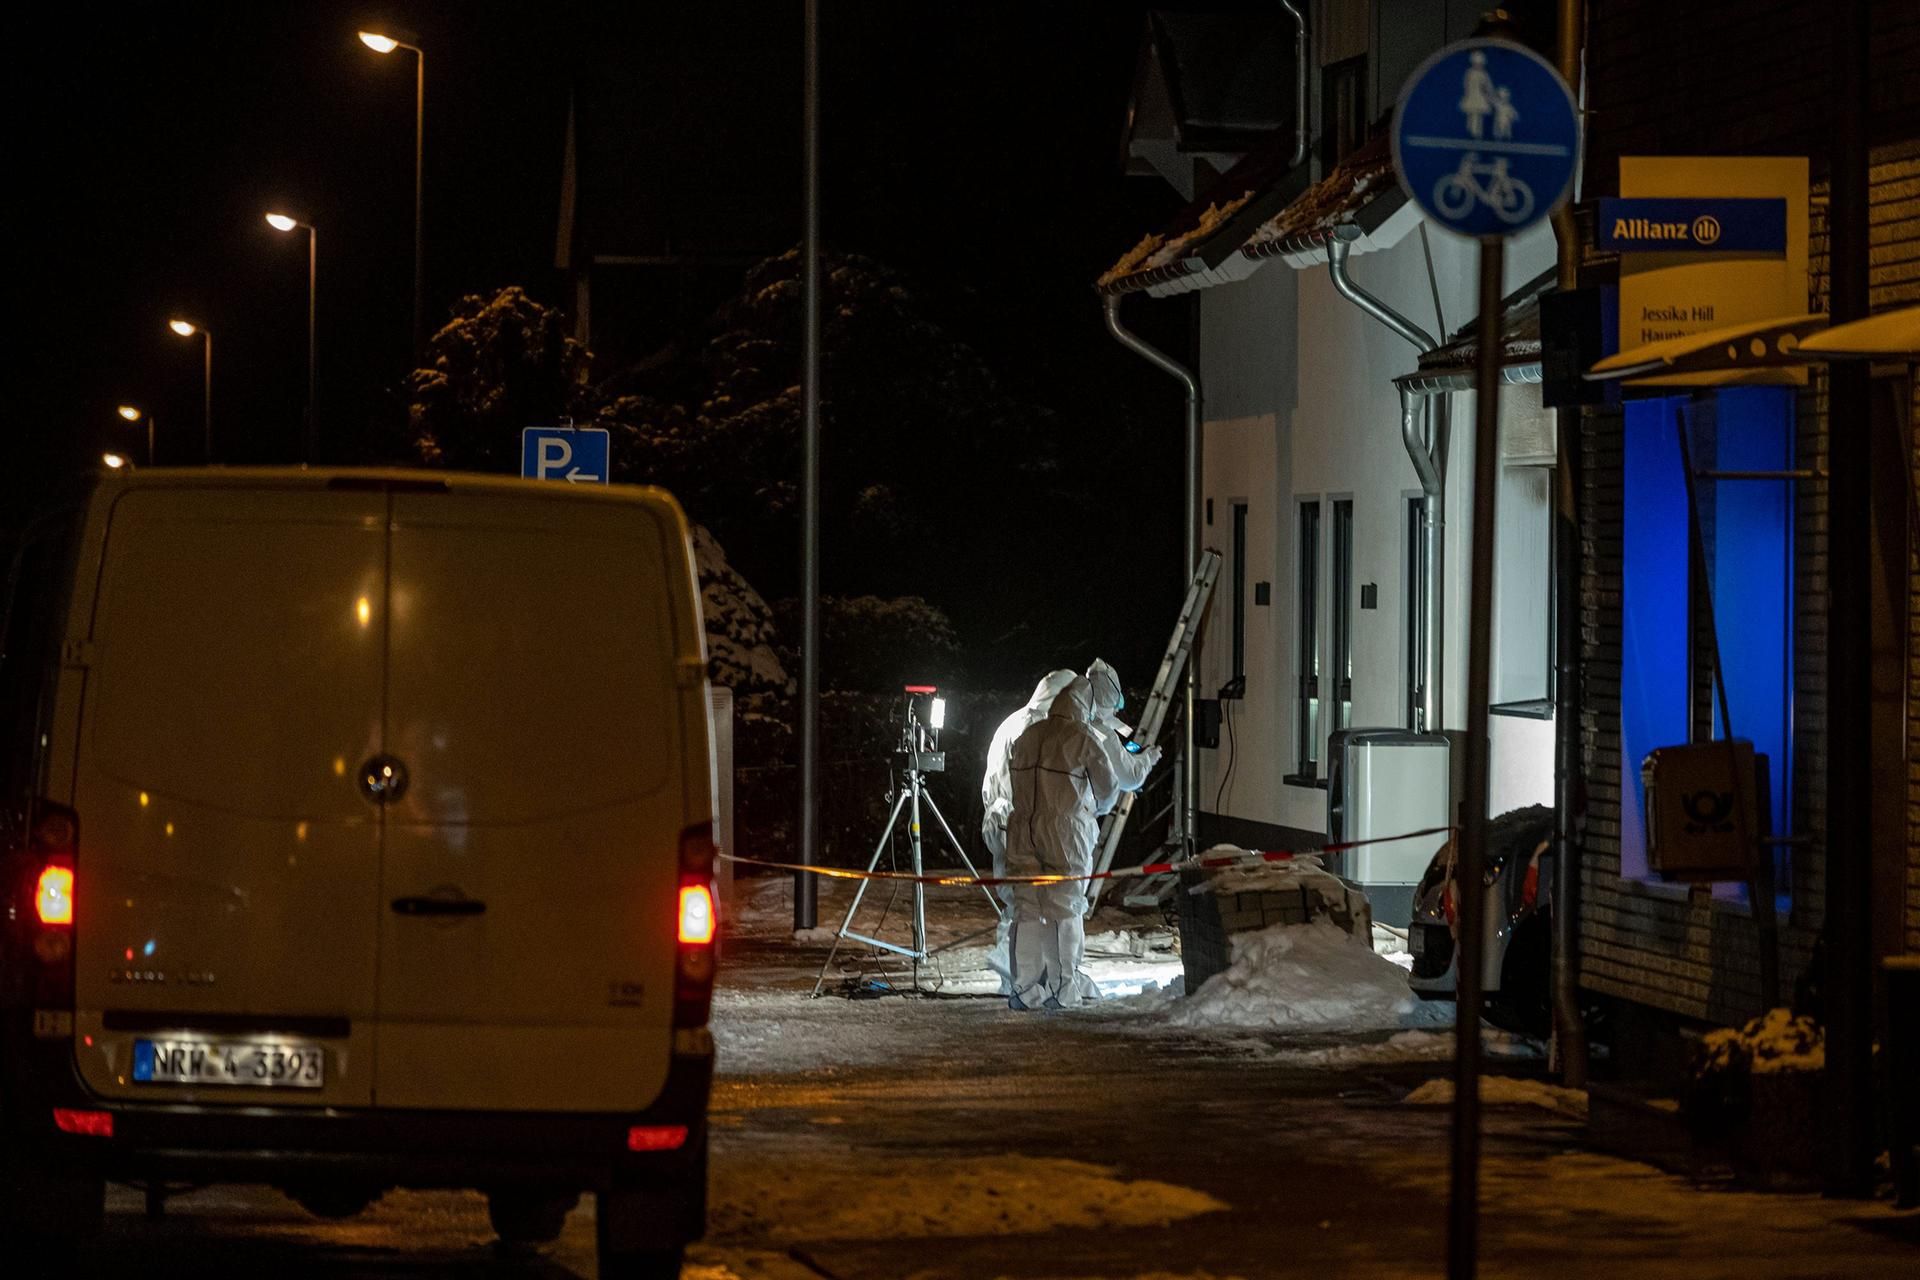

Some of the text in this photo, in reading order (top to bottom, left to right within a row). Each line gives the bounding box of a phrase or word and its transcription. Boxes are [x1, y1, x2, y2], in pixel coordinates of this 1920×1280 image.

[1613, 219, 1688, 239] Allianz
[1642, 306, 1714, 321] Jessika Hill
[538, 437, 572, 481] P
[153, 1047, 205, 1075] NRW
